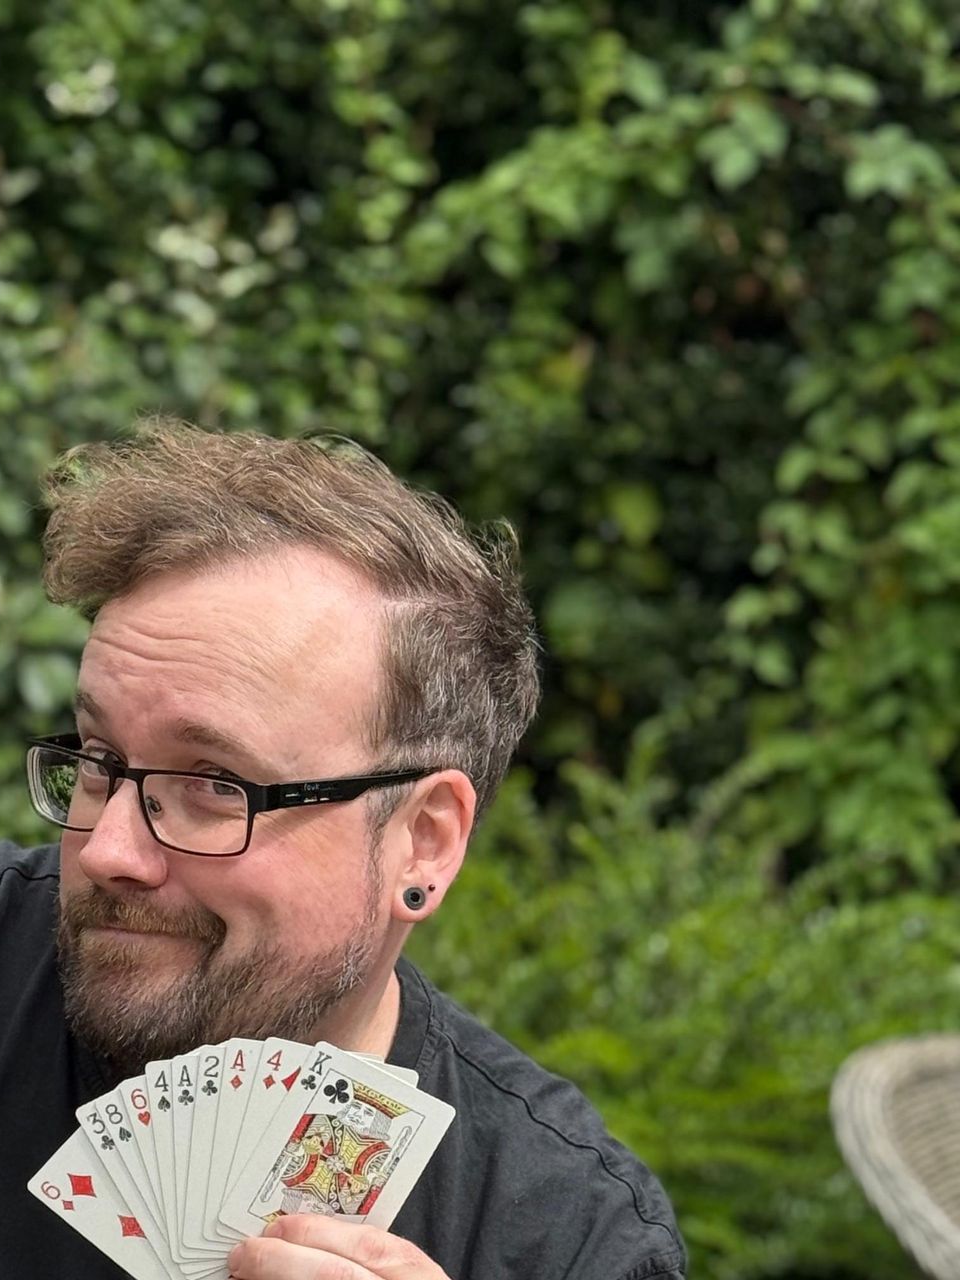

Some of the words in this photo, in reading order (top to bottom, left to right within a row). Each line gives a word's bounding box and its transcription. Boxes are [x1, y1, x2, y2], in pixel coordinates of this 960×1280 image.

[204, 1055, 220, 1078] 2
[230, 1049, 246, 1071] A
[266, 1050, 283, 1071] 4
[309, 1051, 332, 1075] K
[154, 1070, 169, 1093] 4
[177, 1065, 193, 1087] A
[130, 1088, 147, 1110] 6
[86, 1112, 106, 1135] 3
[105, 1103, 123, 1125] 8
[40, 1181, 61, 1200] 6
